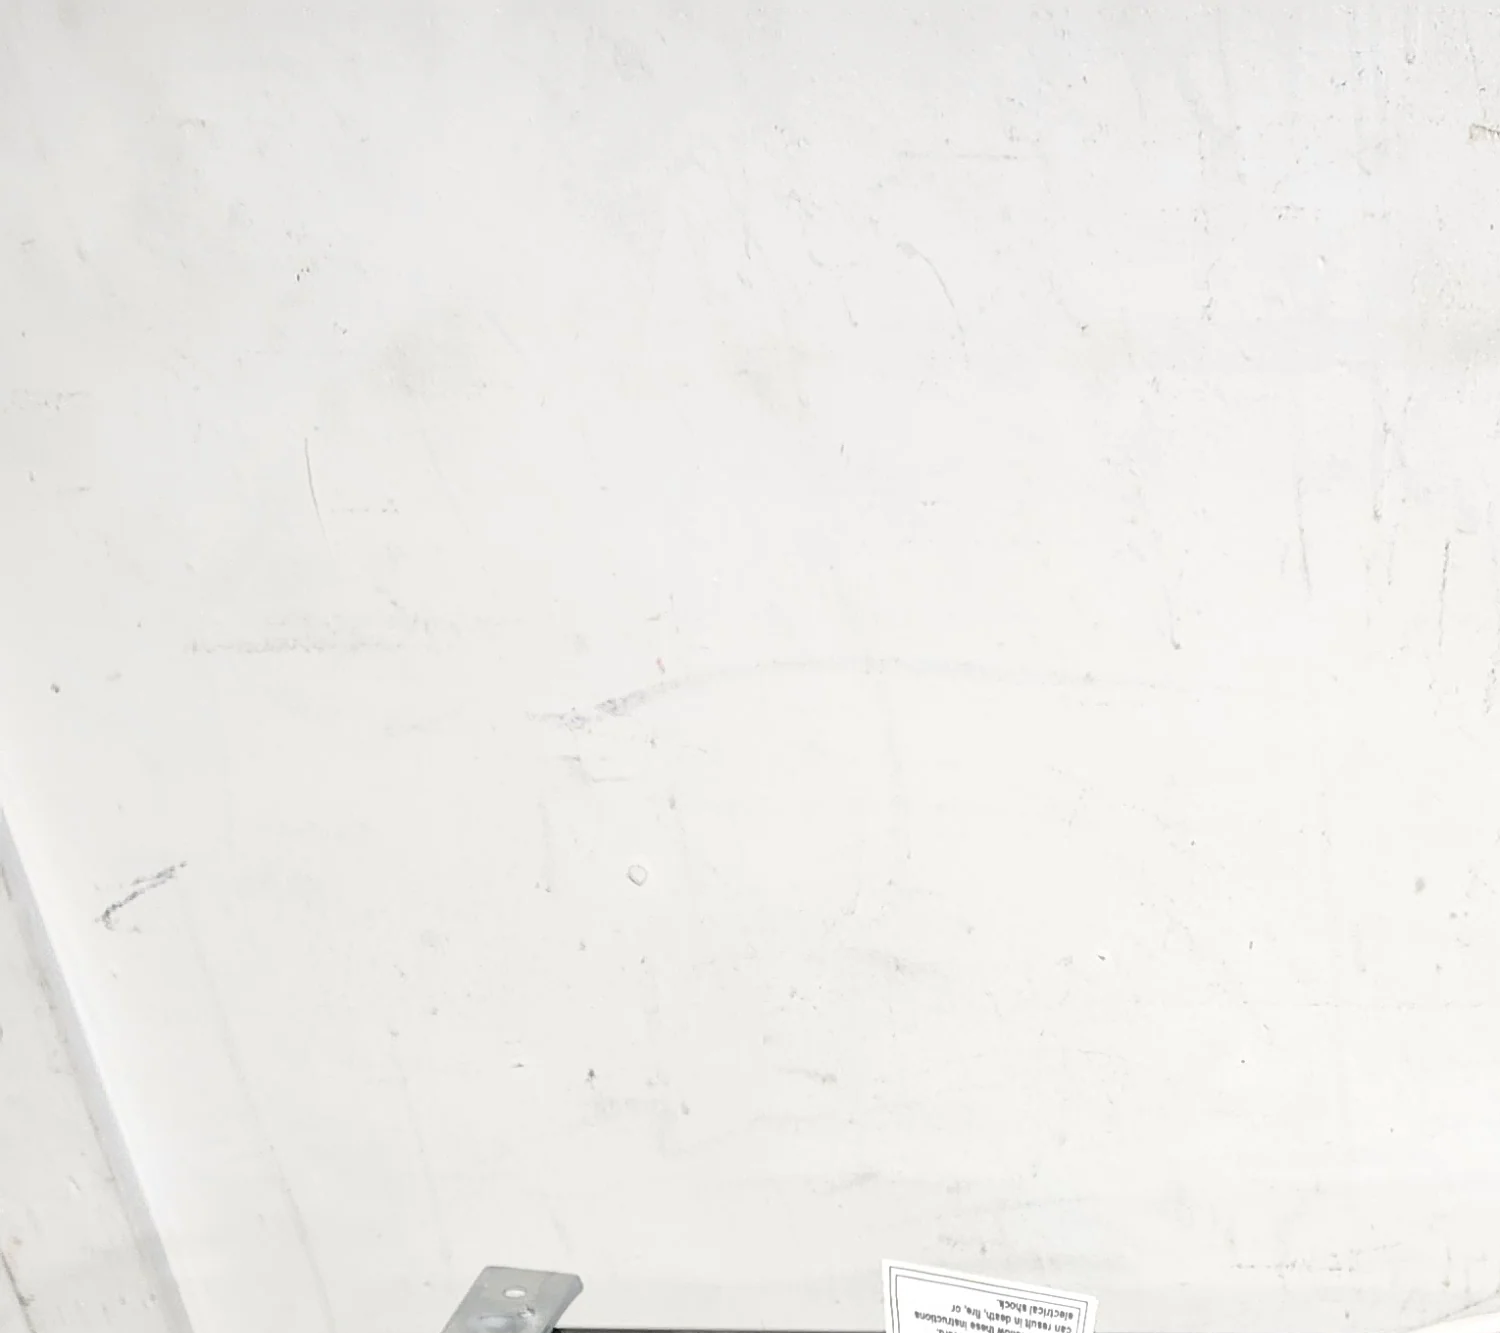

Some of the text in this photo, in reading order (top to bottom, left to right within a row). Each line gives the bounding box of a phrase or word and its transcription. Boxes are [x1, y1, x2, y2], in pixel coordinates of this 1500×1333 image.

[951, 1304, 961, 1313] or
[964, 1304, 981, 1320] fire,
[983, 1308, 1011, 1325] death,
[996, 1299, 1073, 1321] electrical shock.
[914, 1311, 967, 1331] instructions
[1014, 1316, 1023, 1328] in
[1024, 1318, 1052, 1331] result
